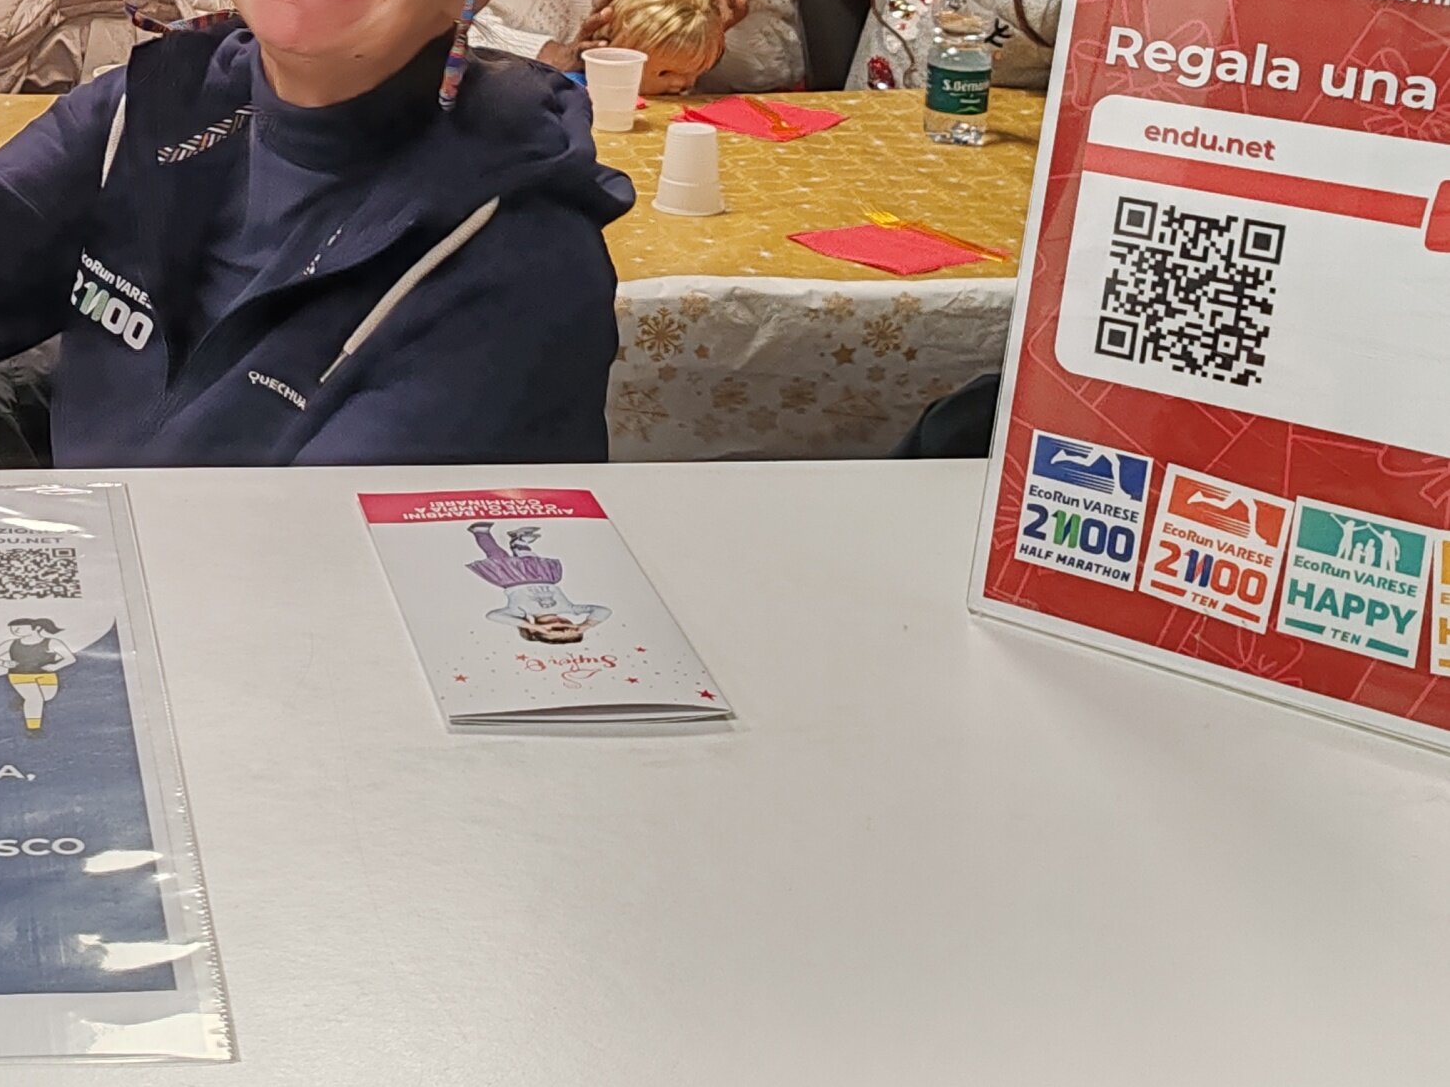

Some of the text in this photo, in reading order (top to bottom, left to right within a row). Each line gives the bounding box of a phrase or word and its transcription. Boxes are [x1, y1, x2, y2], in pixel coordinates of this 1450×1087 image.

[1105, 26, 1437, 111] Regala una
[1144, 123, 1276, 161] endu.net
[81, 251, 153, 309] coRun VARE
[248, 370, 306, 411] QUECHUA
[403, 509, 478, 520] BAMBINI
[1029, 484, 1140, 524] EcoRun VARESE
[1019, 544, 1131, 583] HALF MARATHON
[1162, 523, 1275, 568] EcoRun VARESE
[1293, 555, 1352, 580] EcoRun
[1353, 569, 1418, 599] VARESE
[1190, 591, 1220, 611] TEN
[1286, 578, 1417, 635] HAPPY
[1330, 627, 1362, 645] TEN
